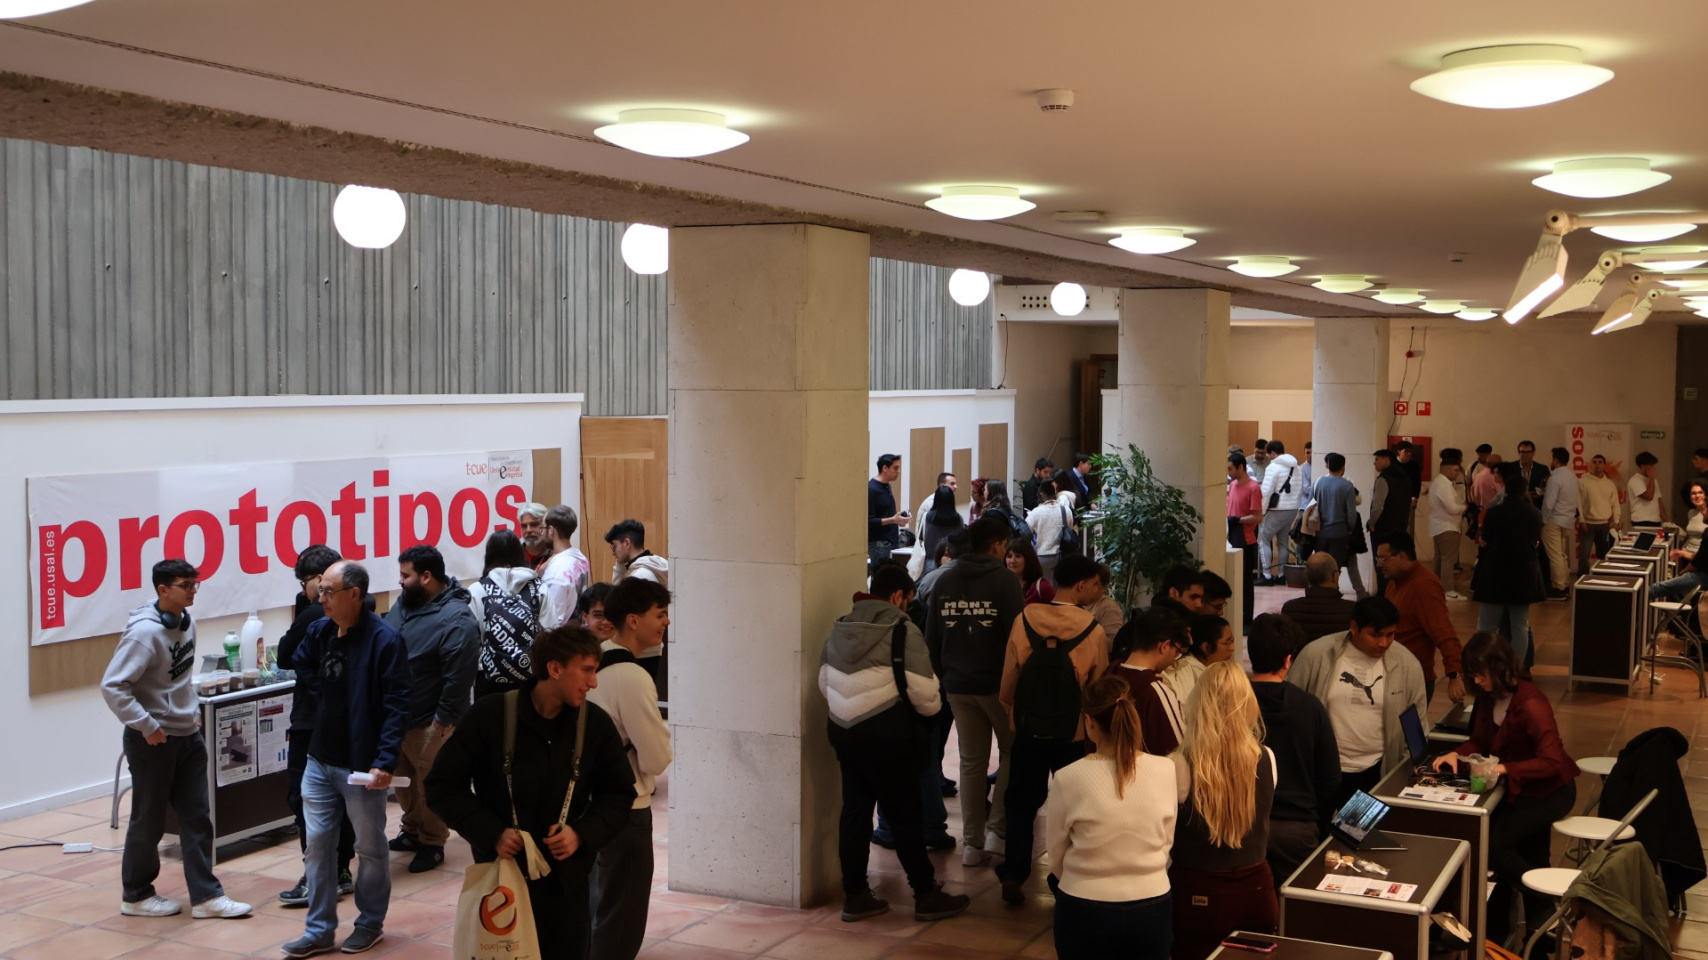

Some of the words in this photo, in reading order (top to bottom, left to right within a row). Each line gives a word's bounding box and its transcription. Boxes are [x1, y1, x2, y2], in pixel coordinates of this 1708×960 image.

[39, 470, 526, 629] prototipos
[43, 530, 57, 621] tcue.usal.es
[941, 608, 997, 616] BLANC
[944, 600, 992, 608] MONT
